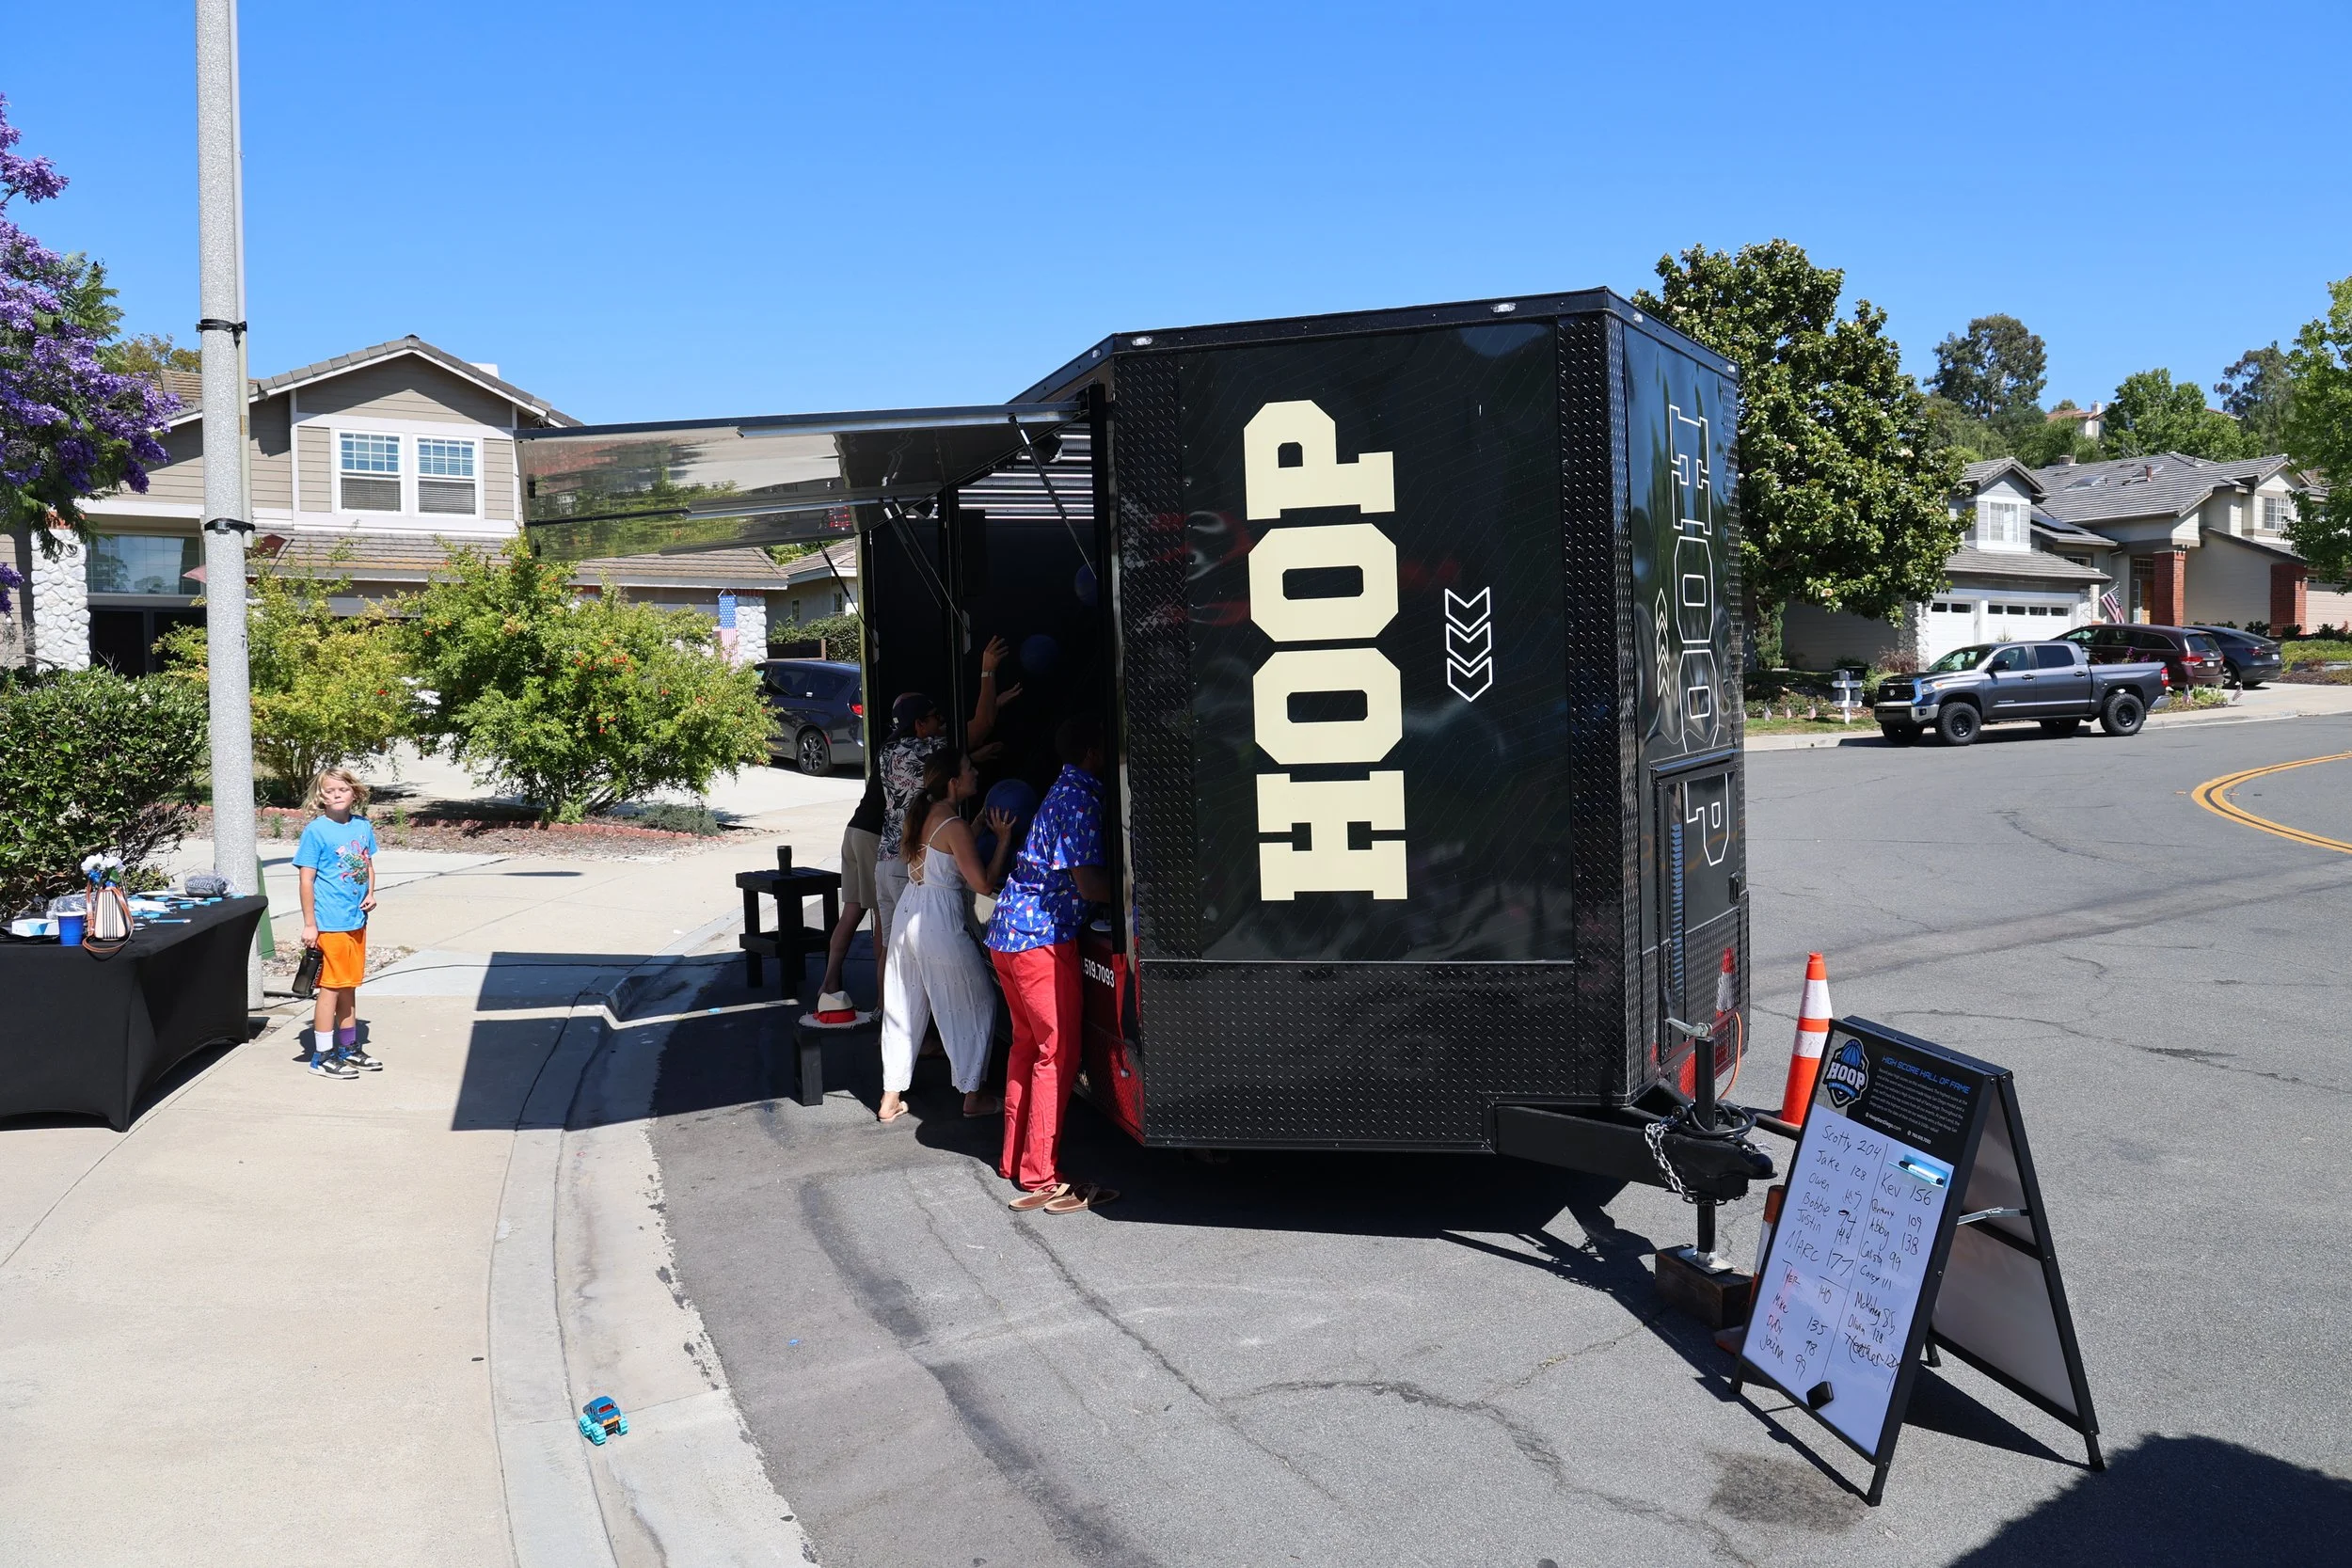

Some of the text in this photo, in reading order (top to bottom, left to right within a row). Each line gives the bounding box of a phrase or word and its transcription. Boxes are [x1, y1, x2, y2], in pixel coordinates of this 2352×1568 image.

[1244, 400, 1407, 901] HOOP
[1826, 1061, 1866, 1091] HOOP
[1882, 1055, 1972, 1095] HIGH SCORE HALL OF FAME
[1821, 1125, 1883, 1161] Scotty 204
[1815, 1149, 1867, 1181] Jake 128
[1808, 1172, 1830, 1193] Owen
[1881, 1172, 1901, 1197] Kev
[1909, 1185, 1932, 1206] 156
[1801, 1192, 1831, 1217] Bobbie
[1797, 1209, 1821, 1235] Justin
[1869, 1217, 1919, 1256] Abby 138
[1907, 1213, 1922, 1233] 109
[1826, 1247, 1854, 1277] 177
[1889, 1251, 1901, 1272] 99
[1772, 1292, 1828, 1336] Mike 135
